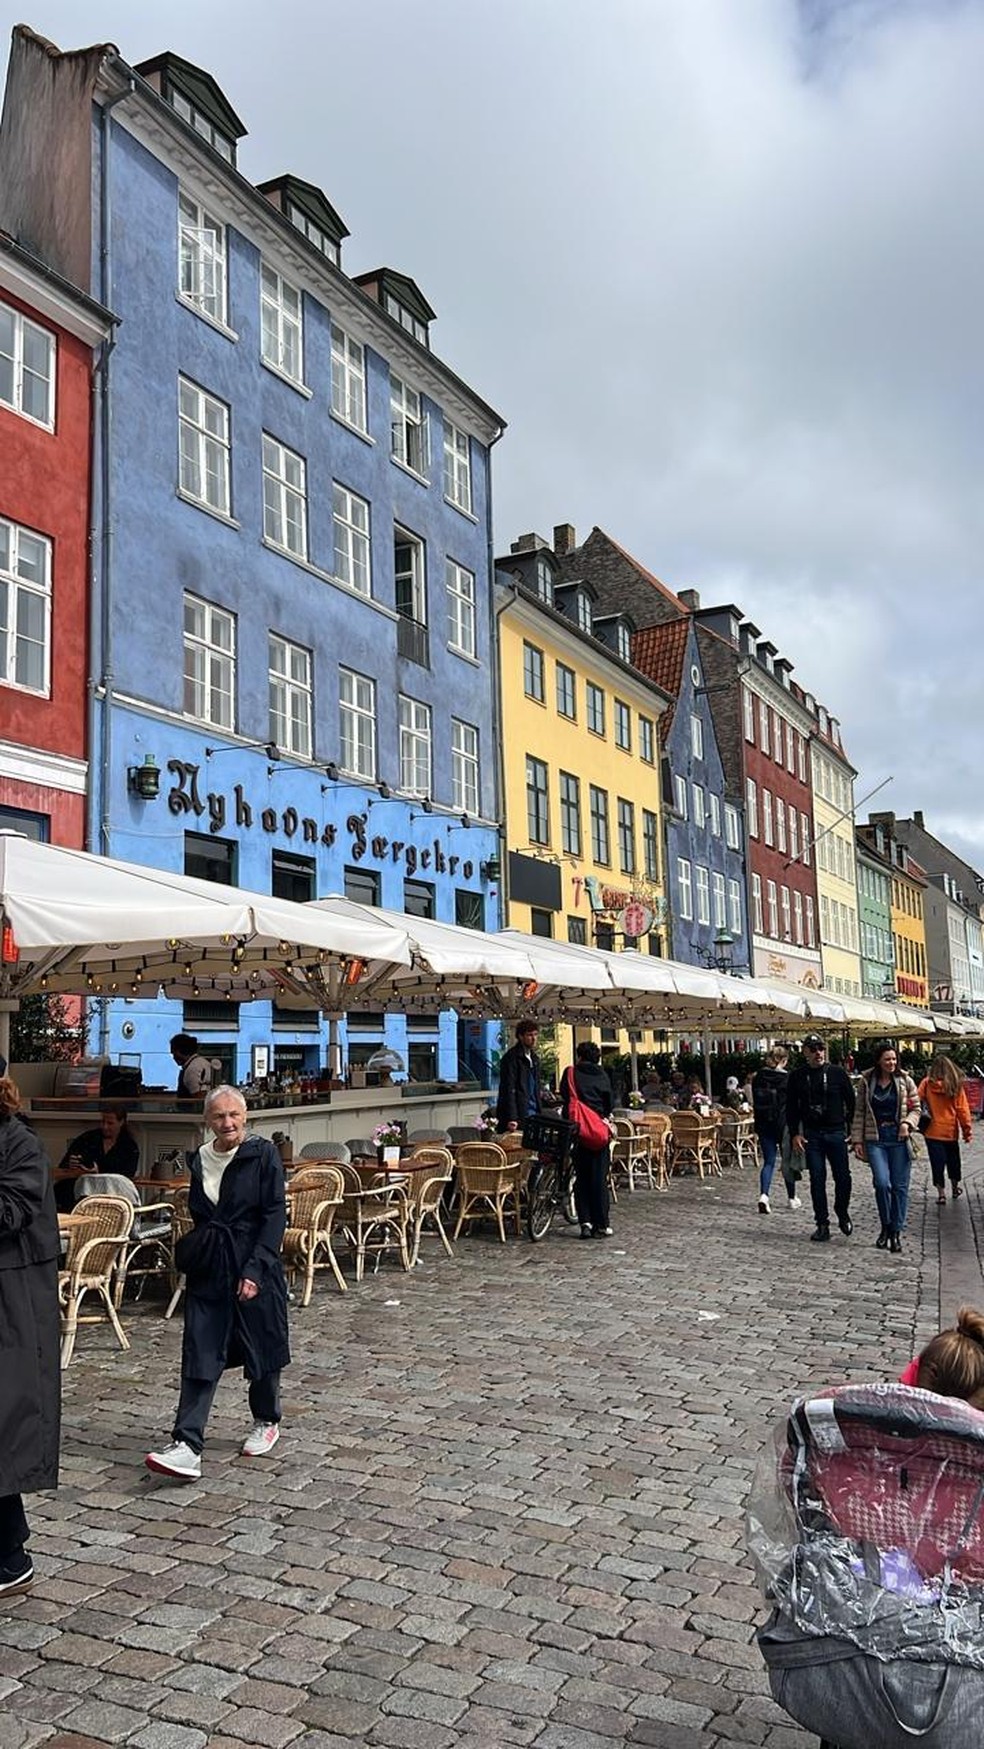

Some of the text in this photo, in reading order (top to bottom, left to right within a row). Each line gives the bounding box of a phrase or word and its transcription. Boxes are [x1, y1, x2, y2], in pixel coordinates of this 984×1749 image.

[168, 759, 474, 879] Nyhavns Færgekro
[934, 986, 951, 1000] 17
